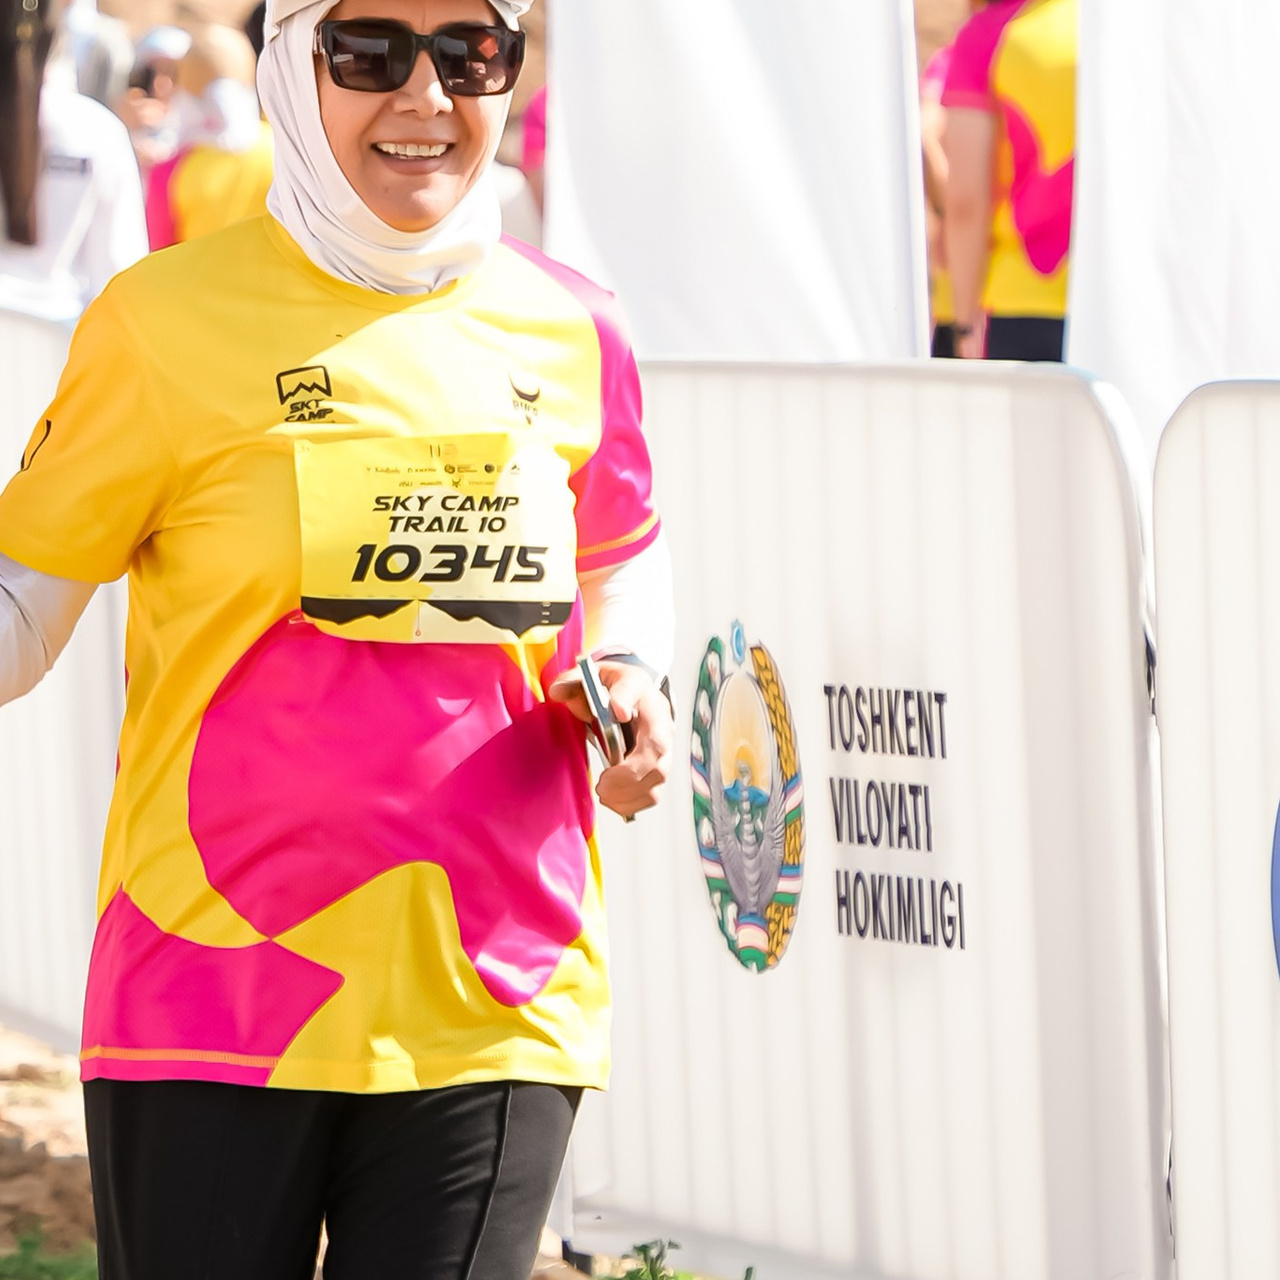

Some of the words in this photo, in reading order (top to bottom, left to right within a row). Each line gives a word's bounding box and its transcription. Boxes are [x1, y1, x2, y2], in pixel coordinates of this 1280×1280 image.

[284, 408, 333, 422] CAMP
[289, 398, 326, 414] SKY
[372, 495, 435, 512] SKY
[440, 495, 519, 512] CAMP
[388, 516, 469, 533] TRAIL
[478, 516, 508, 533] 10
[350, 544, 549, 583] 10345
[823, 684, 948, 760] TOSHKENT
[828, 777, 933, 852] VILOYATI
[834, 870, 966, 951] HOKIMLIGI
